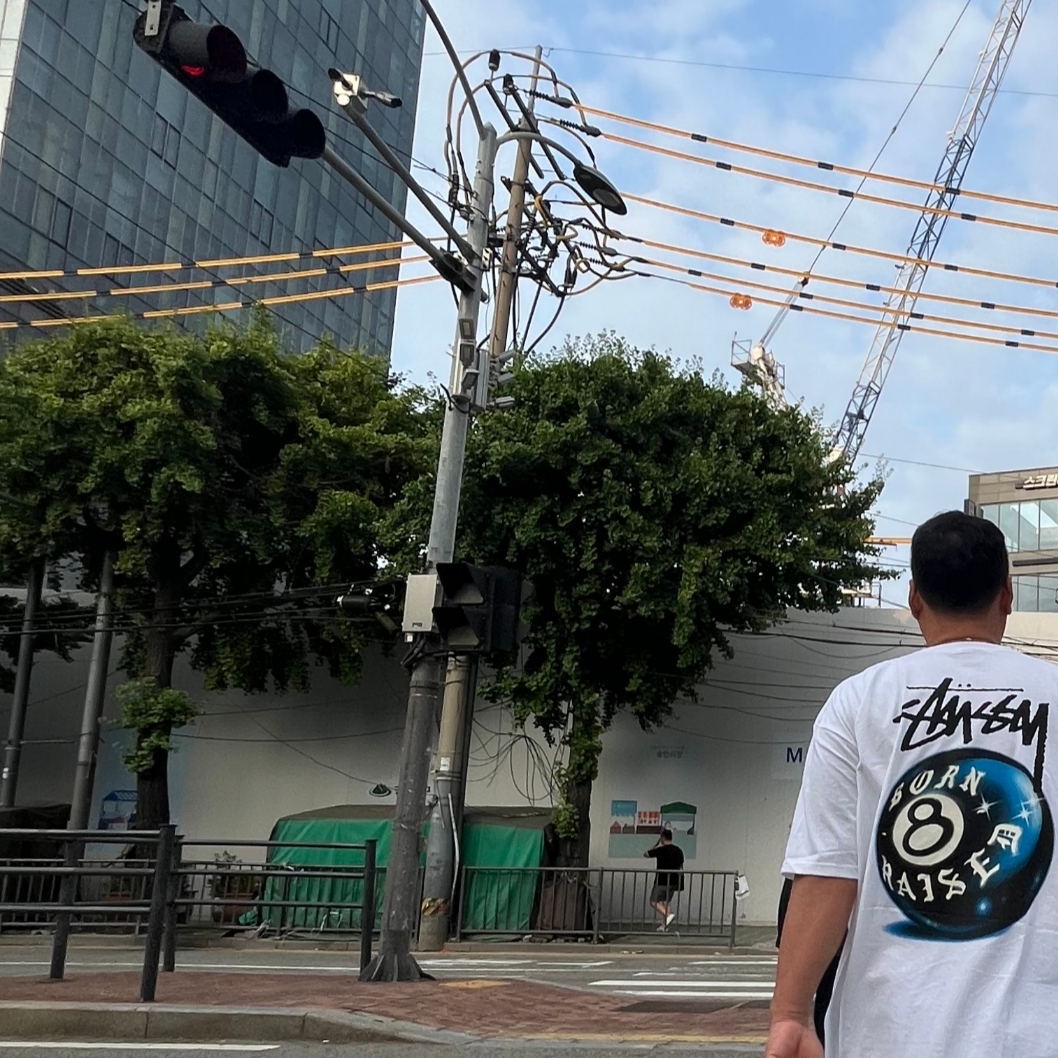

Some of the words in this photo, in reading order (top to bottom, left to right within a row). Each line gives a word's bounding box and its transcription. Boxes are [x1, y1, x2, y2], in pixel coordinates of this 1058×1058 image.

[890, 765, 985, 809] BORN
[902, 798, 955, 857] 8
[881, 823, 1023, 903] RAISED
